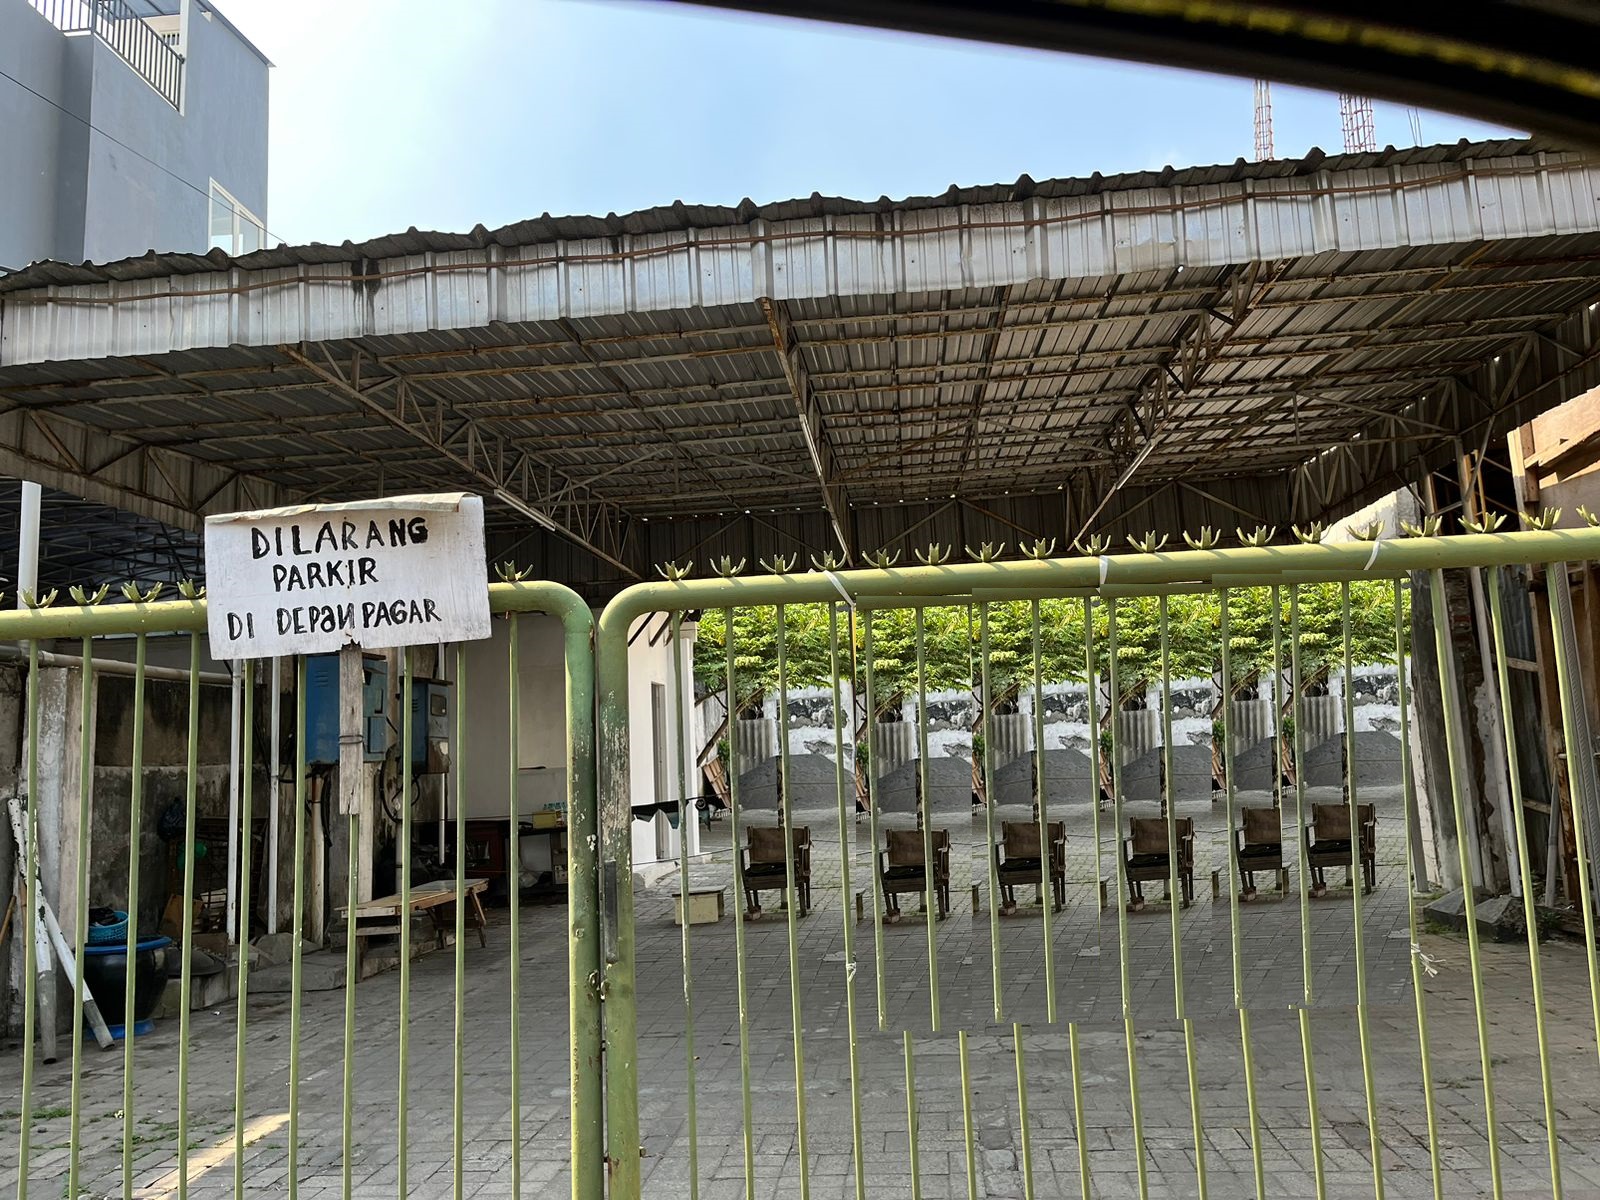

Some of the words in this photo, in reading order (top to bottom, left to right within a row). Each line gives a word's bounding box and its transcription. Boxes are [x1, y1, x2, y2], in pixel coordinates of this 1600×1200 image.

[251, 517, 428, 559] DILARANG
[273, 557, 378, 592] PARKIR
[227, 612, 254, 640] DI
[362, 598, 442, 628] PAGAR
